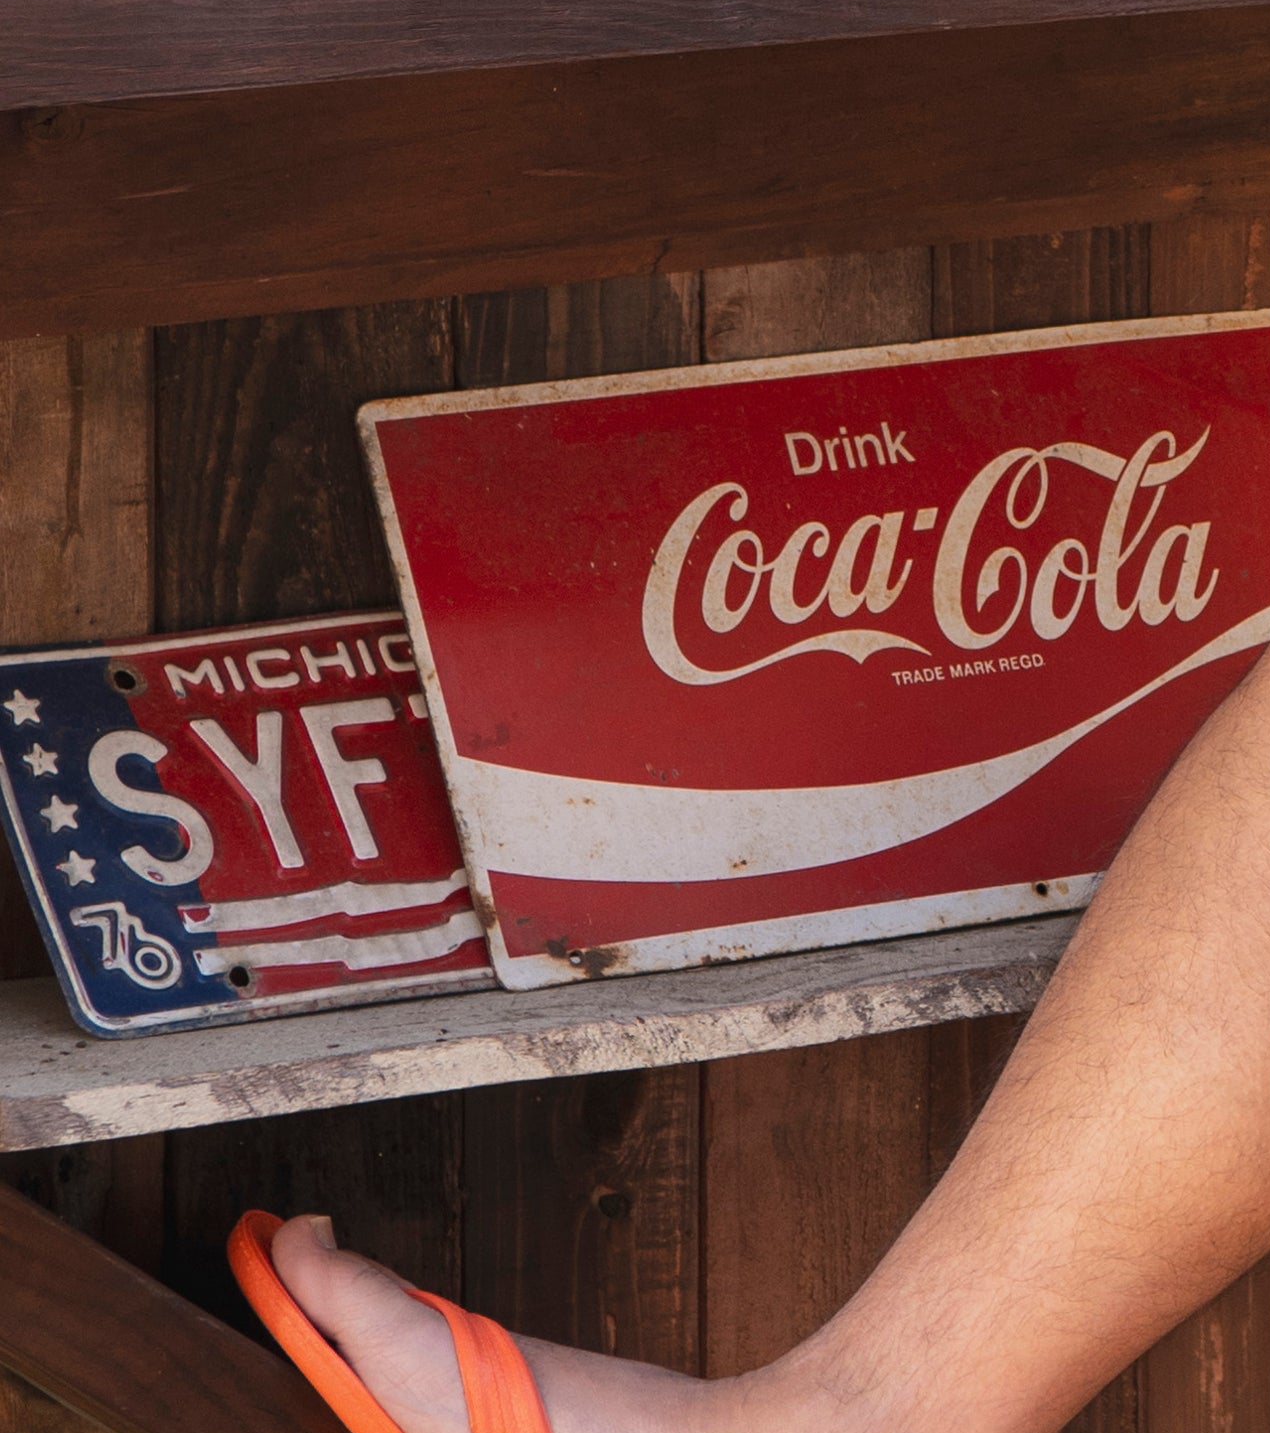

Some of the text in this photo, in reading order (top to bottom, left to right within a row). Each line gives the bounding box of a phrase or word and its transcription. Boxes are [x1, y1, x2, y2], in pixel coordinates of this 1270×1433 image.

[784, 421, 915, 476] Drink
[640, 423, 1220, 687] Coca-Cola
[891, 666, 946, 687] TRADE
[949, 659, 997, 679] MARK
